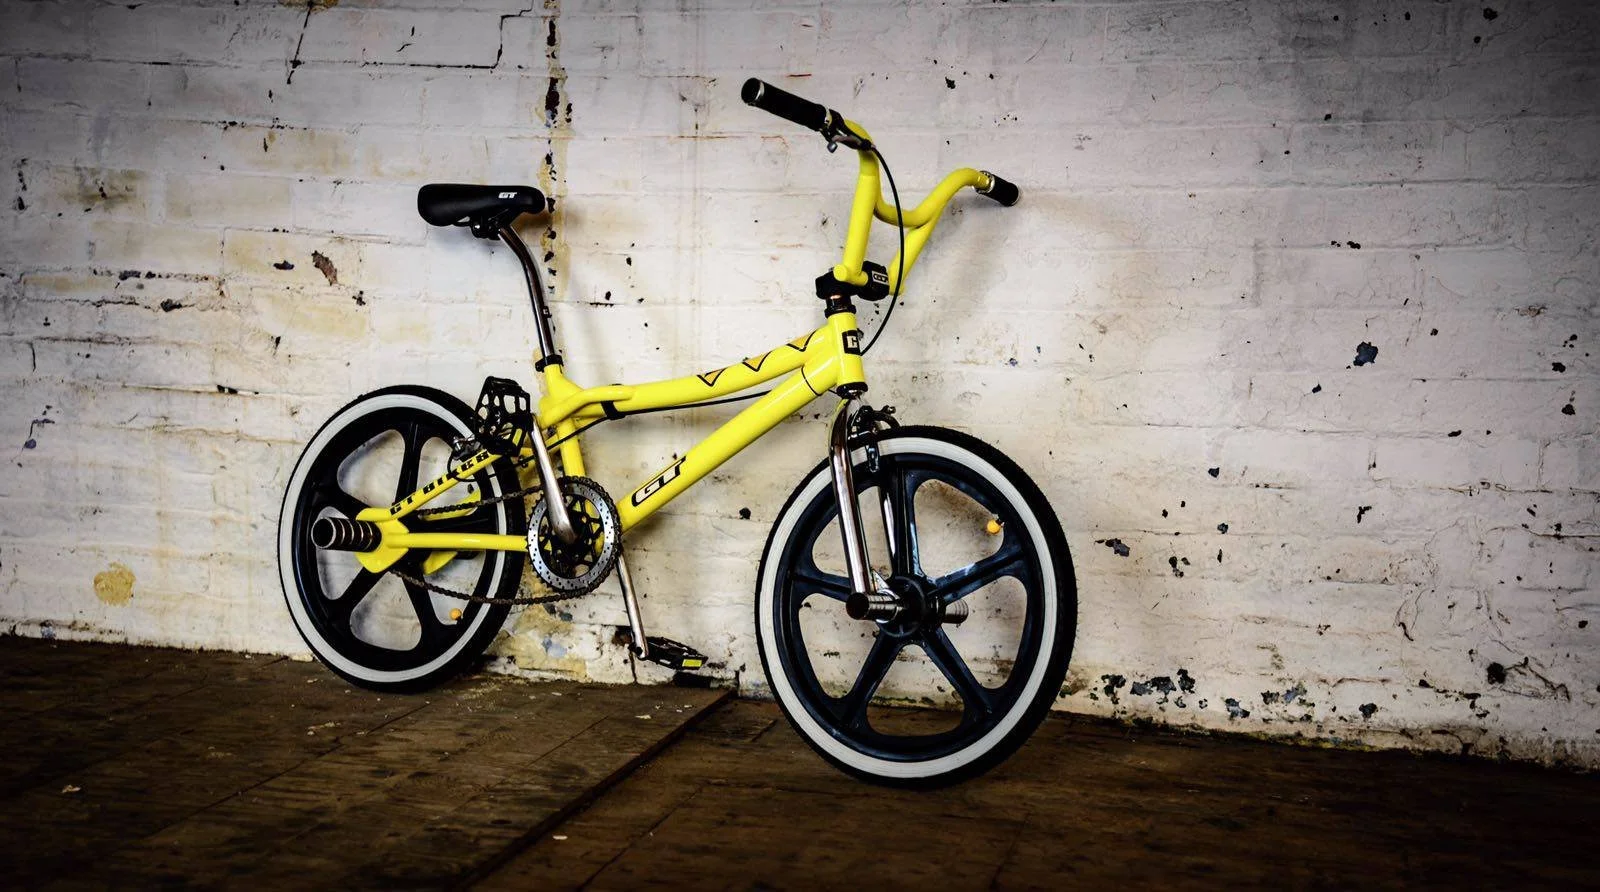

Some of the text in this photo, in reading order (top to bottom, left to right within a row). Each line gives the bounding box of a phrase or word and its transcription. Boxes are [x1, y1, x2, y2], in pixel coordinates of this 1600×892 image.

[498, 191, 518, 199] GT
[631, 455, 687, 507] GT
[389, 496, 413, 516] GT
